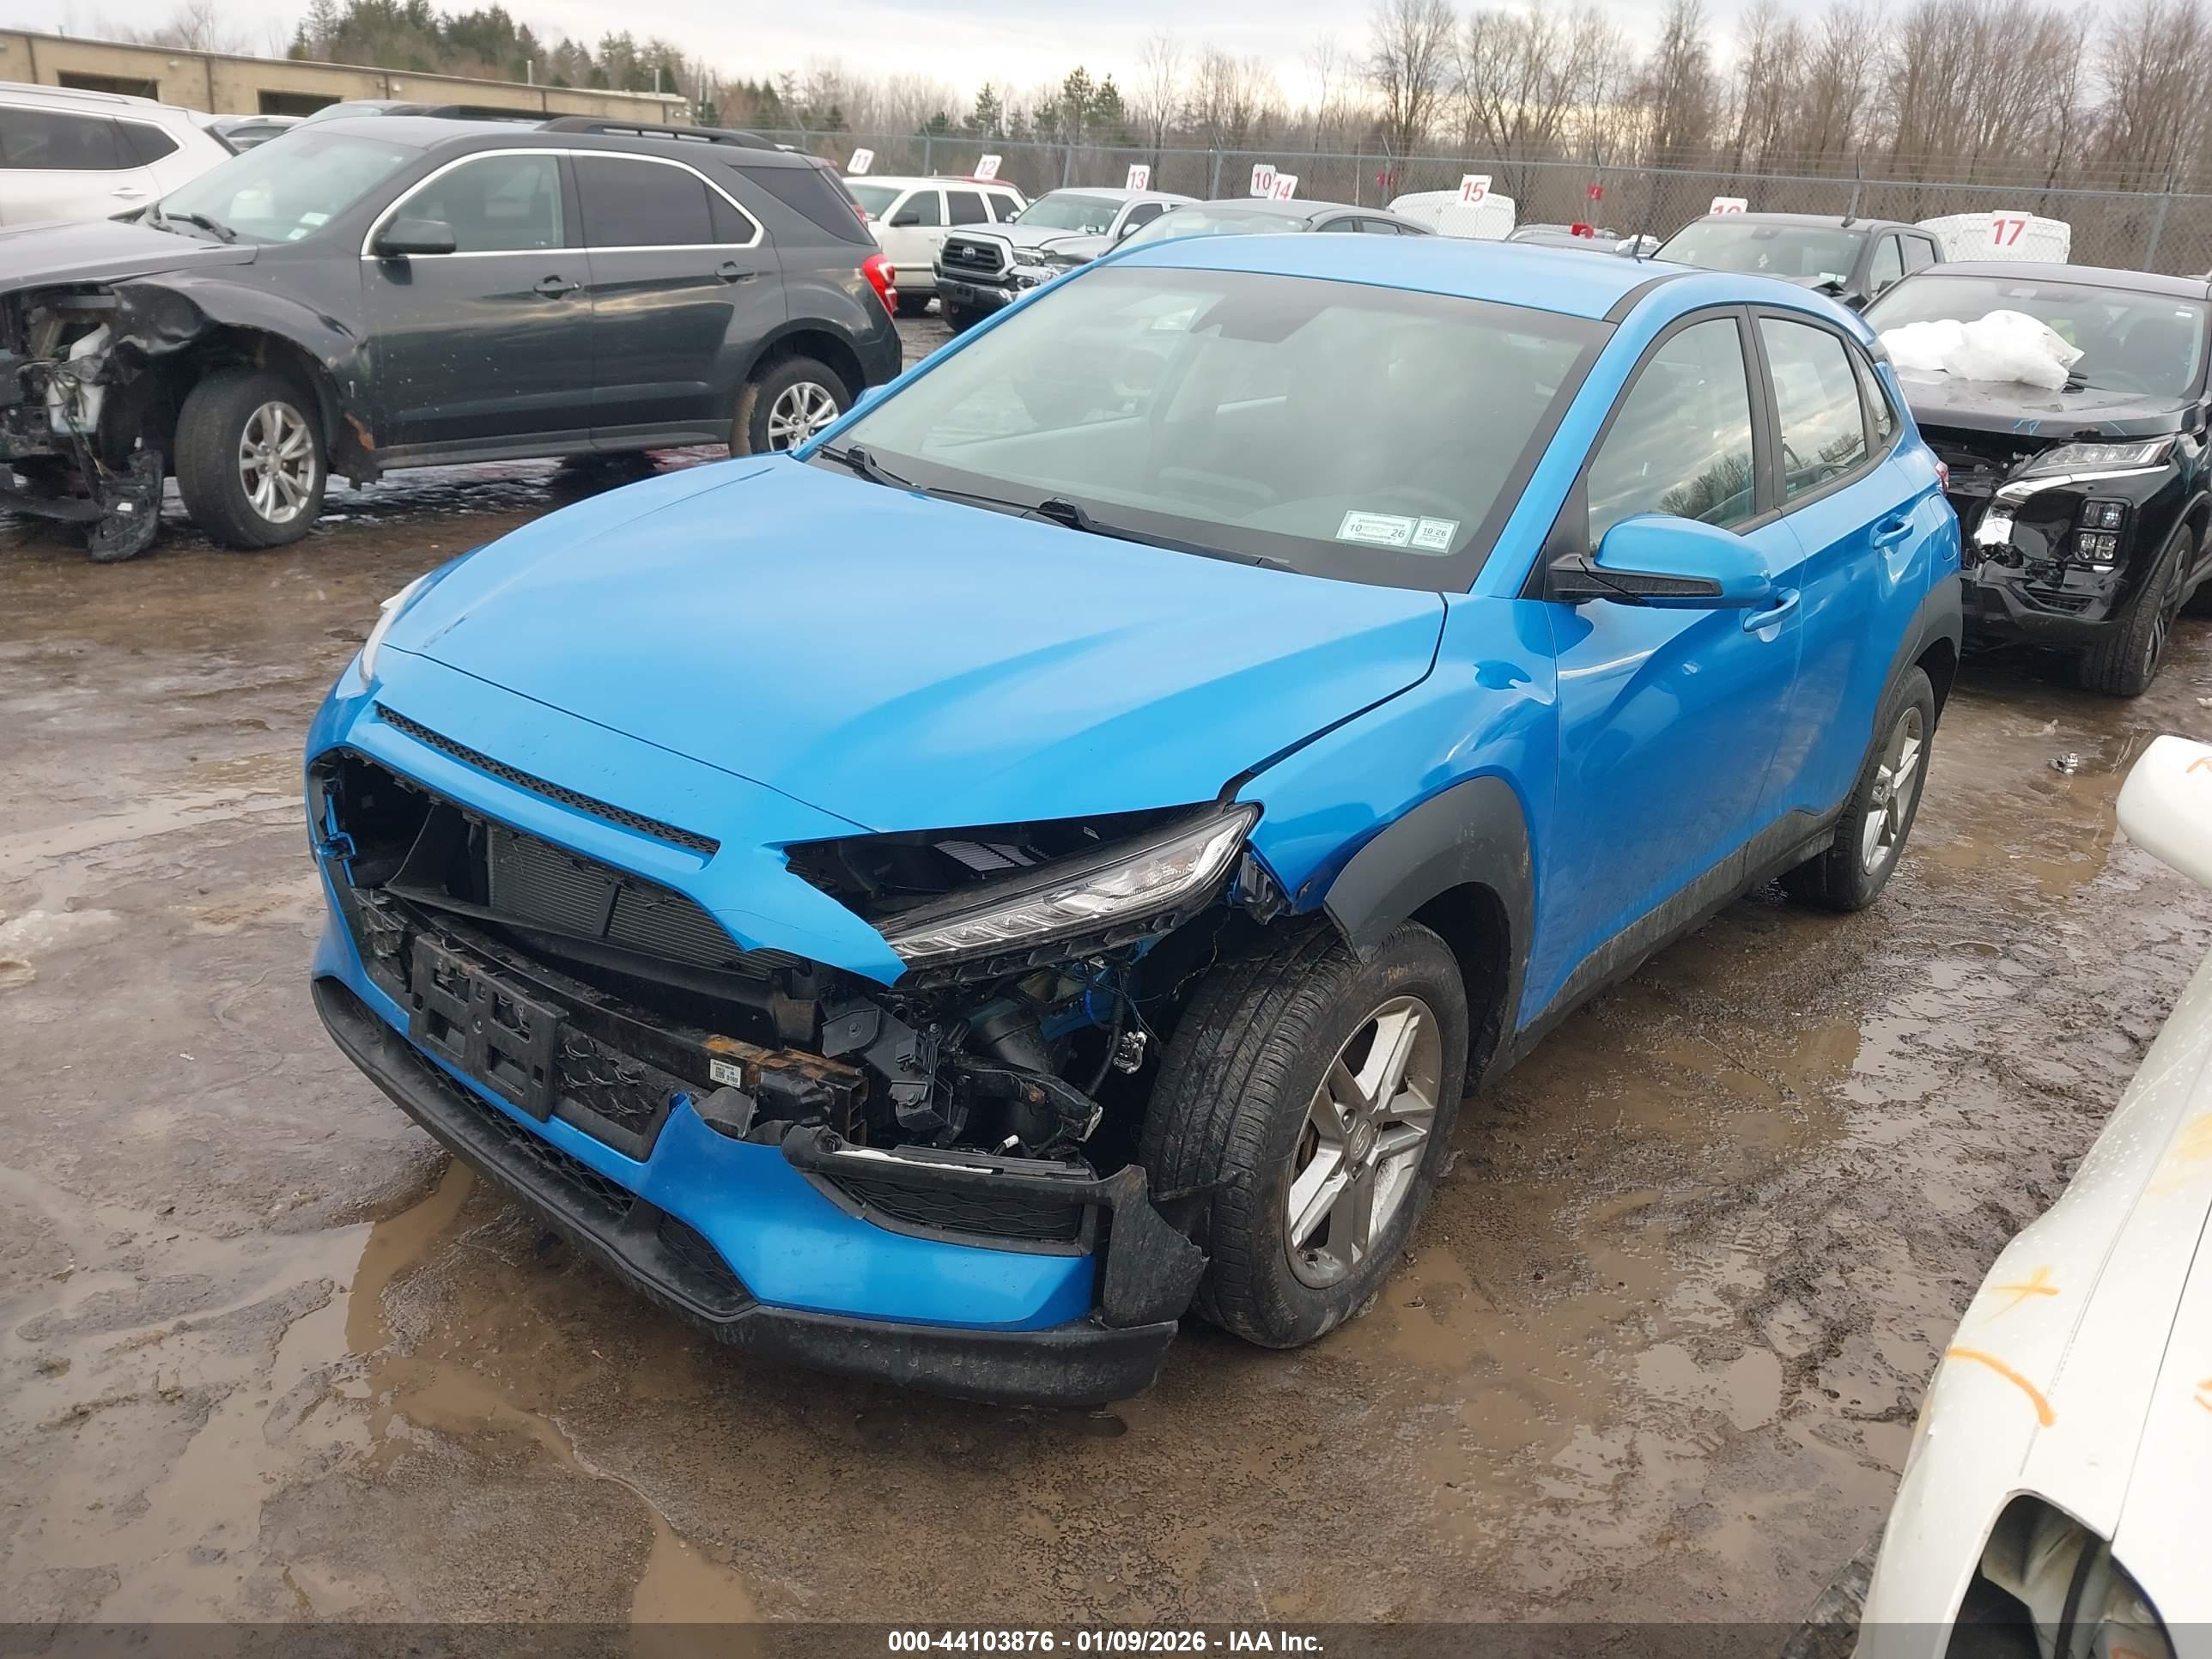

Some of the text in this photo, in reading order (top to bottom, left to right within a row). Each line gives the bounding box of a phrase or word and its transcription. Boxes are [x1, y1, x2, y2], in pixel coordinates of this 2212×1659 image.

[854, 154, 870, 169] 11
[981, 160, 997, 175] 12
[1130, 171, 1146, 190] 13
[1255, 172, 1272, 191] 10
[1274, 180, 1291, 199] 14
[1462, 182, 1486, 203] 15
[1993, 219, 2027, 246] 17
[1390, 528, 1406, 538] 26
